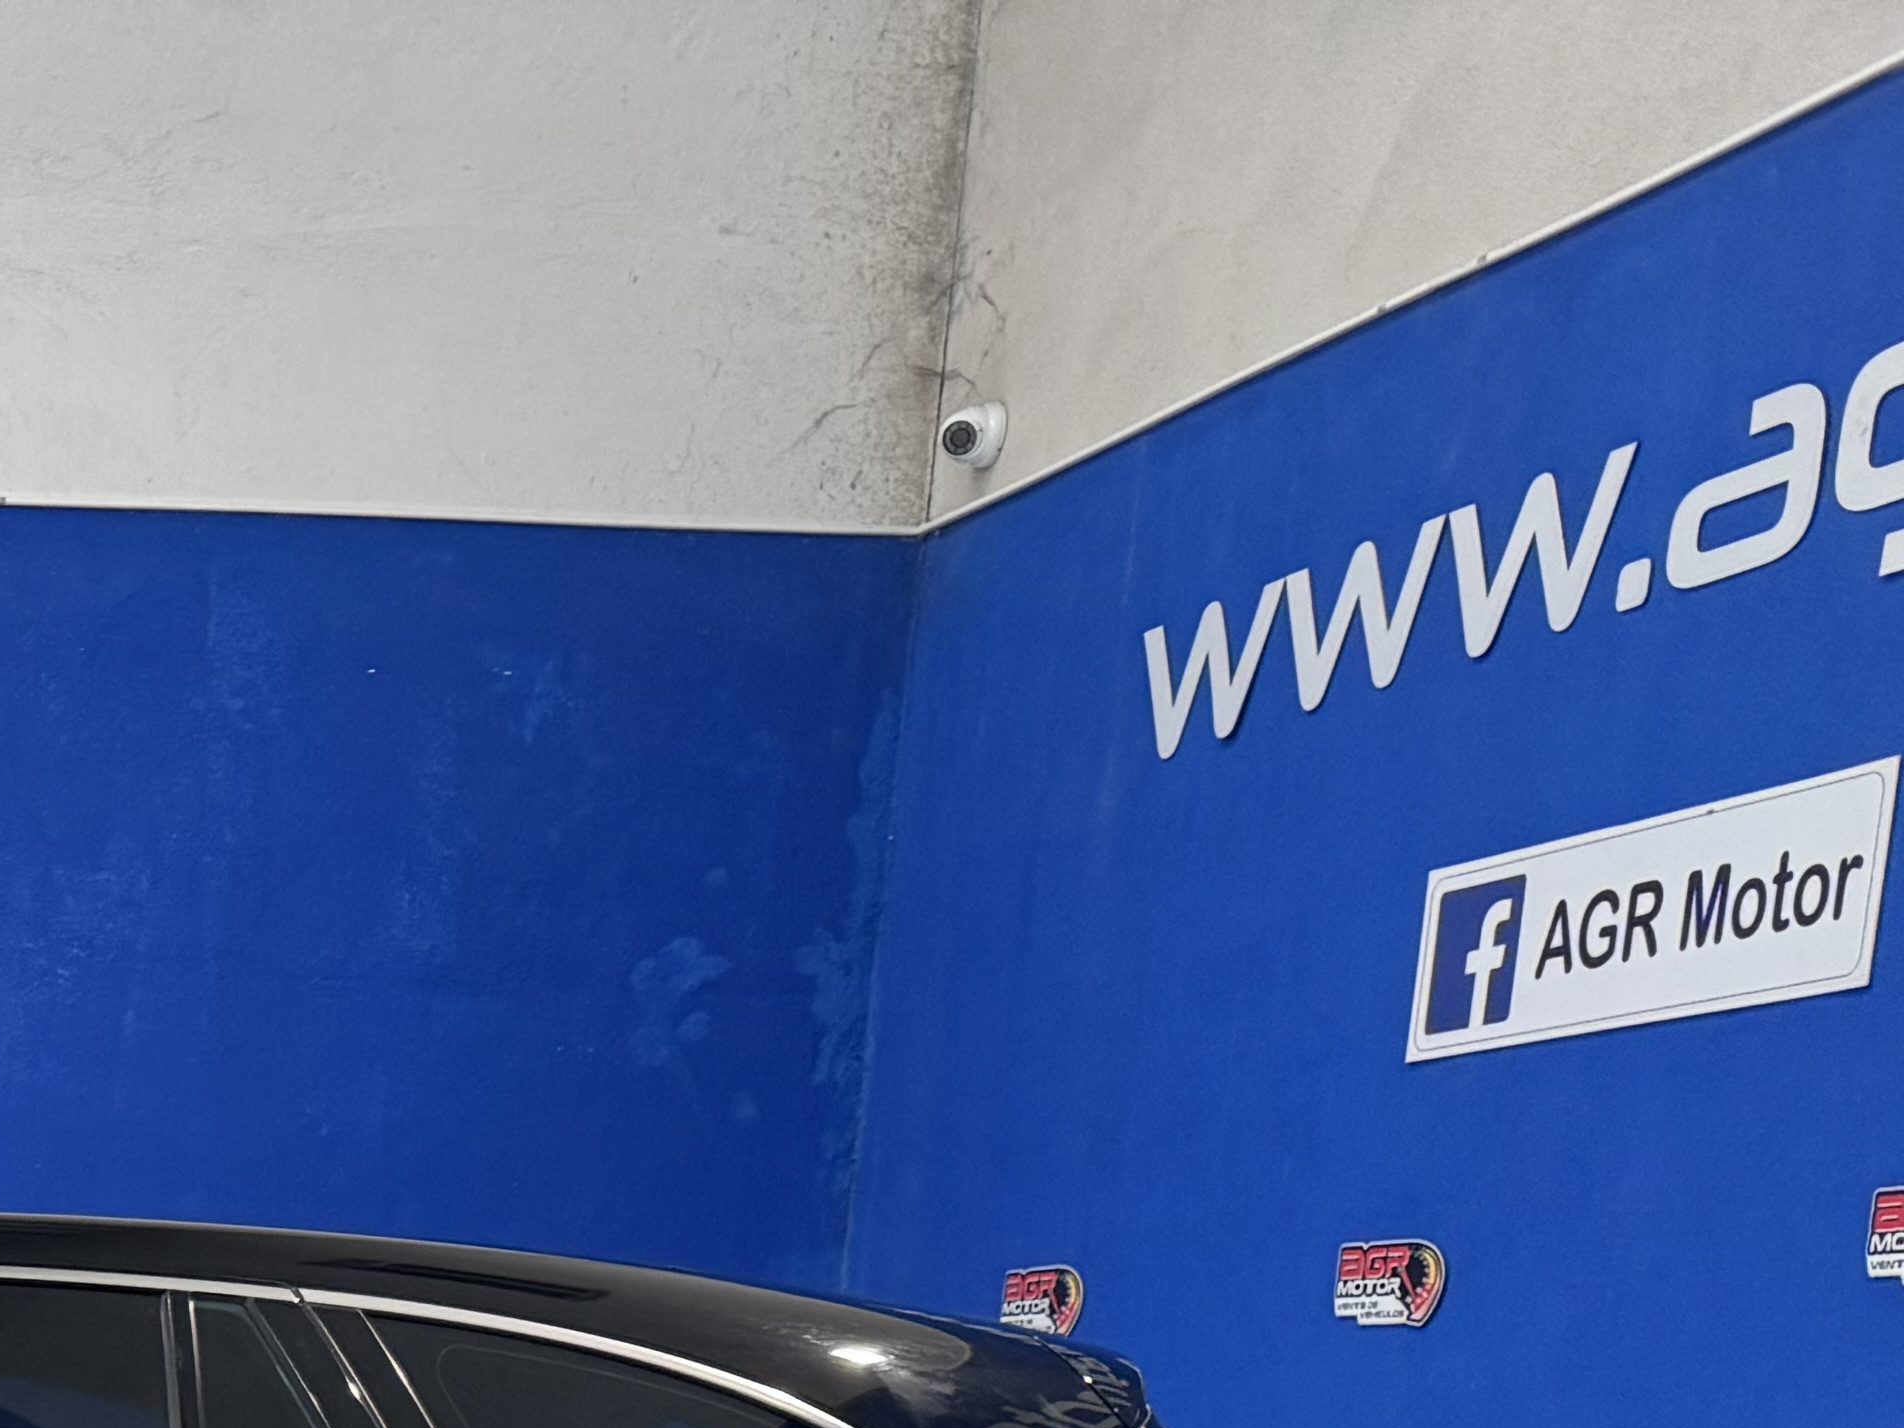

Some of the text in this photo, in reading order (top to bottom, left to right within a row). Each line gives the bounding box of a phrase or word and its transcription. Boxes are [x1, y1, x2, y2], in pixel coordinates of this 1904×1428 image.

[1535, 878, 1664, 981] AGR
[1679, 850, 1864, 953] Motor
[1337, 1277, 1401, 1297] MOTOR
[1002, 1298, 1050, 1314] MOTOR
